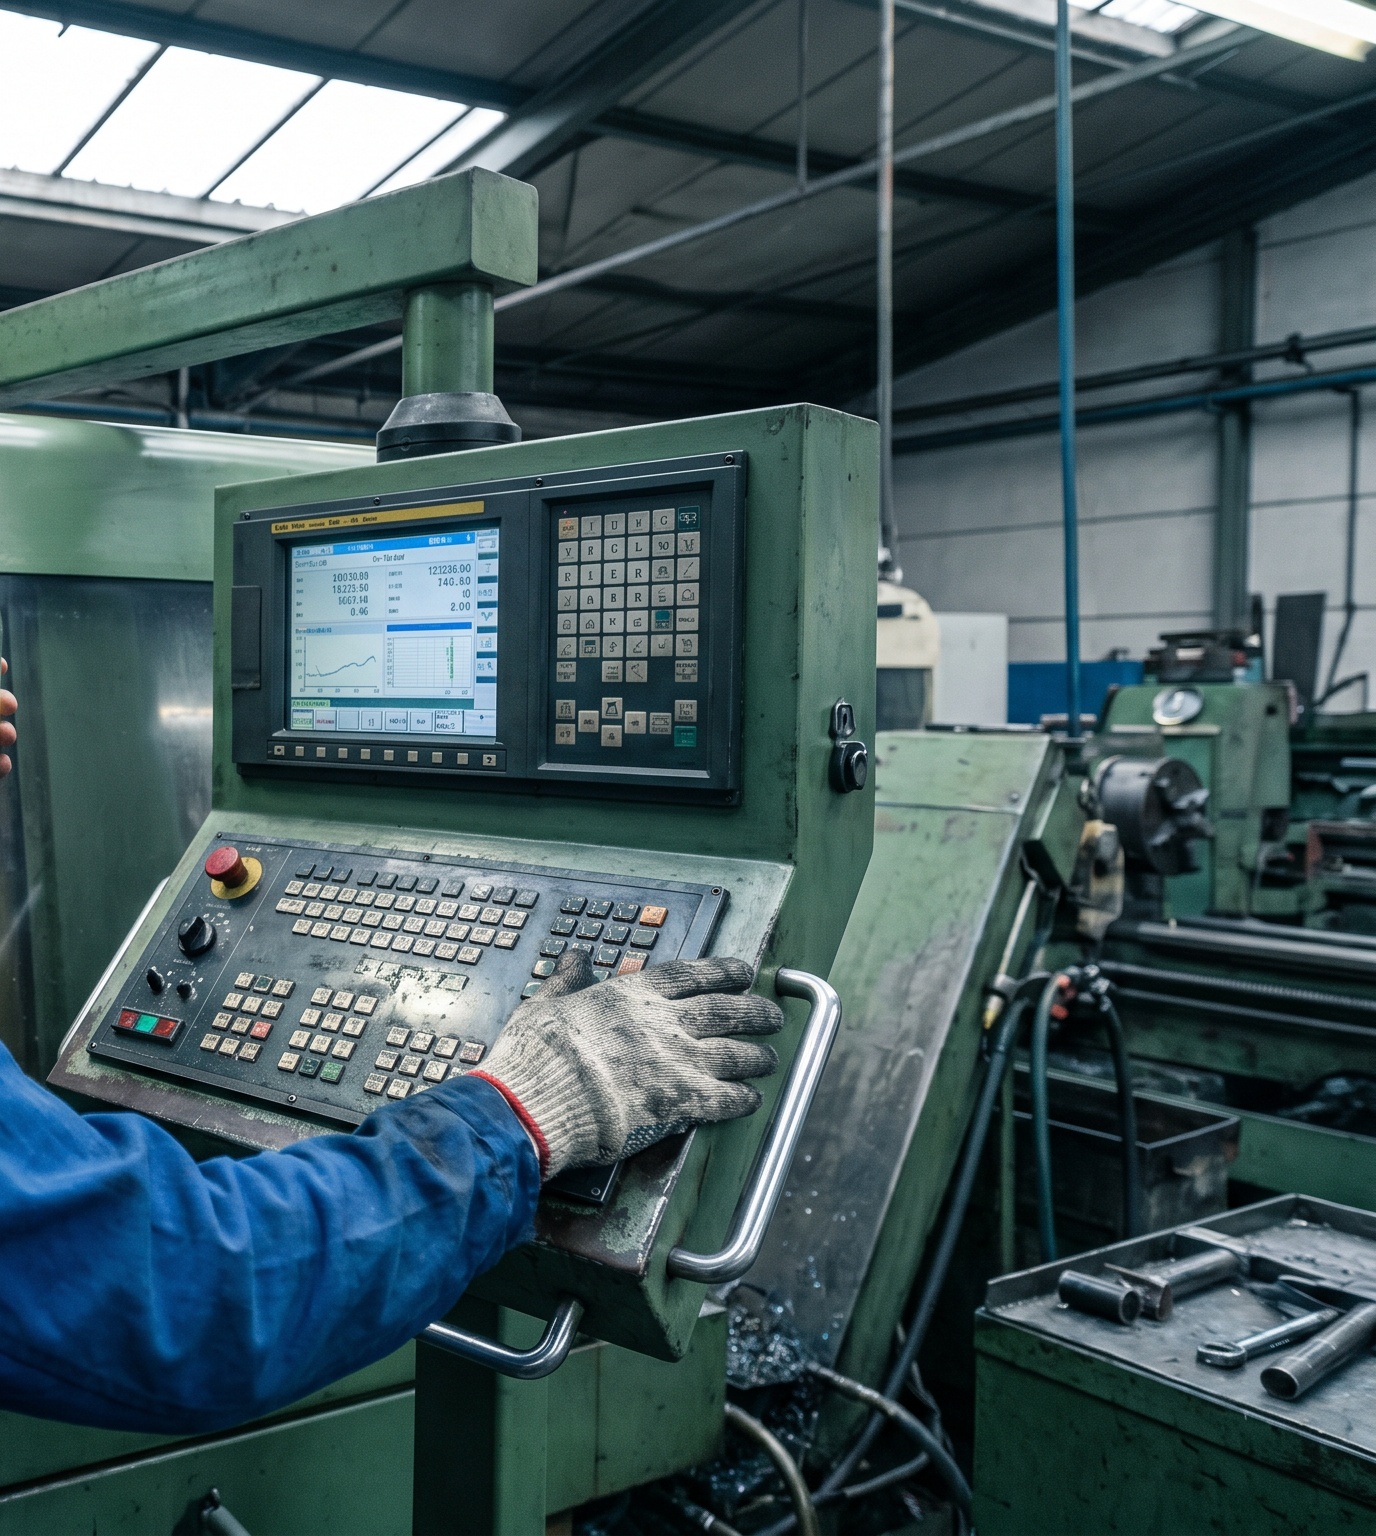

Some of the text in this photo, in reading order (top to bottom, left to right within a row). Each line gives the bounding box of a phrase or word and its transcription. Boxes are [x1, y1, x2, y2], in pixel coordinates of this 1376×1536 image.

[611, 520, 618, 530] U
[635, 542, 643, 552] L
[564, 572, 571, 582] R
[611, 569, 617, 579] E
[635, 568, 642, 578] R
[610, 593, 617, 603] B
[634, 592, 642, 602] R
